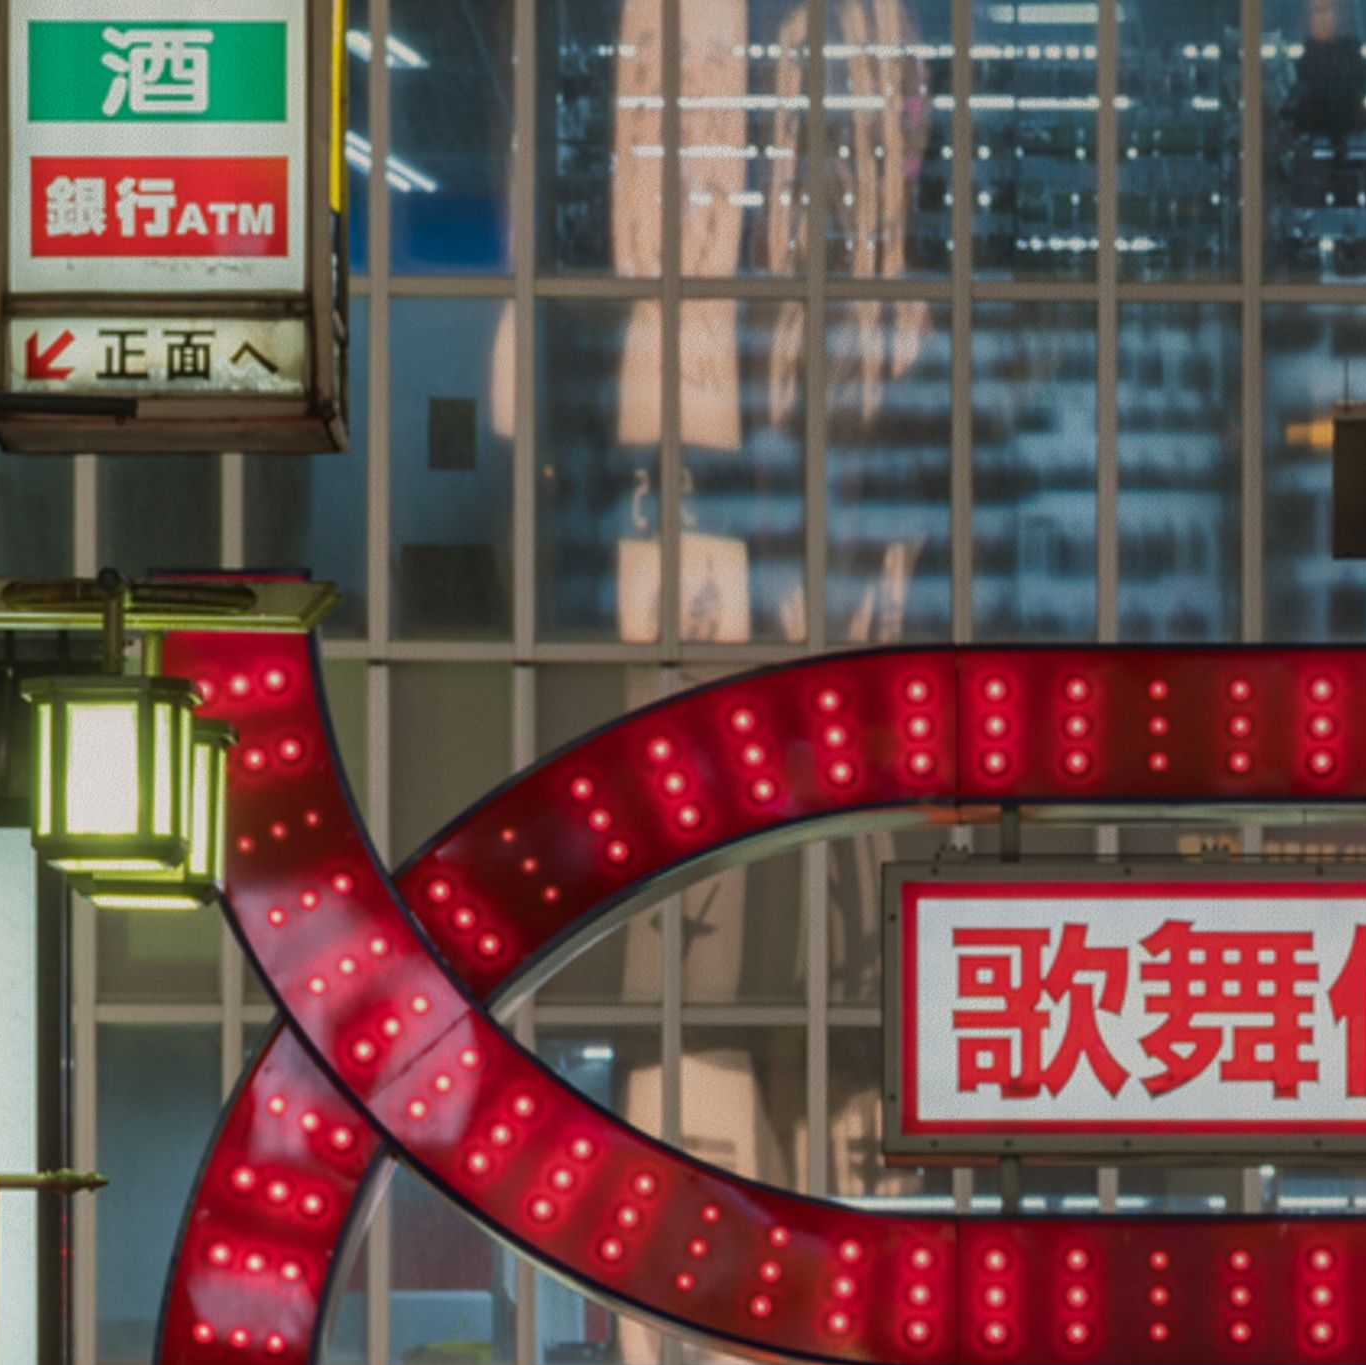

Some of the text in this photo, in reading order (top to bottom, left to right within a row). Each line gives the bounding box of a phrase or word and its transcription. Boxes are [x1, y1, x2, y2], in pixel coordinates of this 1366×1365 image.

[100, 26, 214, 117] 酒
[45, 176, 275, 238] 銀行ATM
[95, 329, 279, 381] 正面へ
